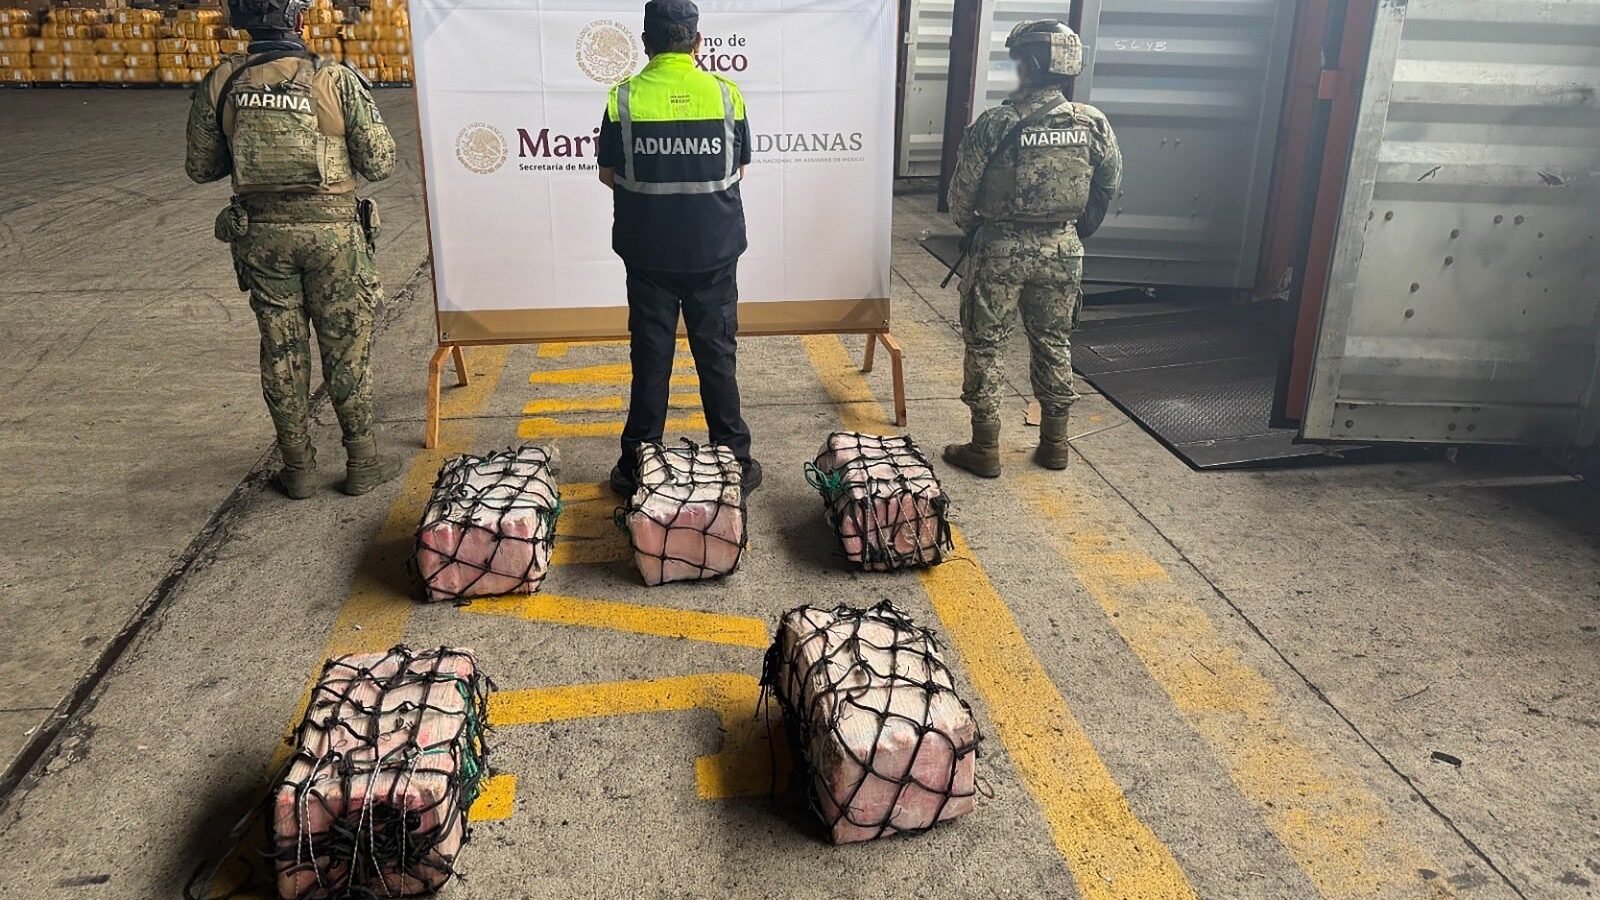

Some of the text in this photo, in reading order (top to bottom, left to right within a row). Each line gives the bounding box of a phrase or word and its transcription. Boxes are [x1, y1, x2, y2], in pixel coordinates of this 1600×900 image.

[728, 34, 746, 47] de
[695, 47, 748, 72] xico
[235, 93, 313, 113] MARINA
[516, 127, 601, 157] Mari
[634, 136, 722, 155] ADUANAS
[751, 132, 863, 153] DUANAS
[1020, 130, 1089, 147] MARINA
[565, 163, 576, 171] de
[578, 163, 598, 171] Mari
